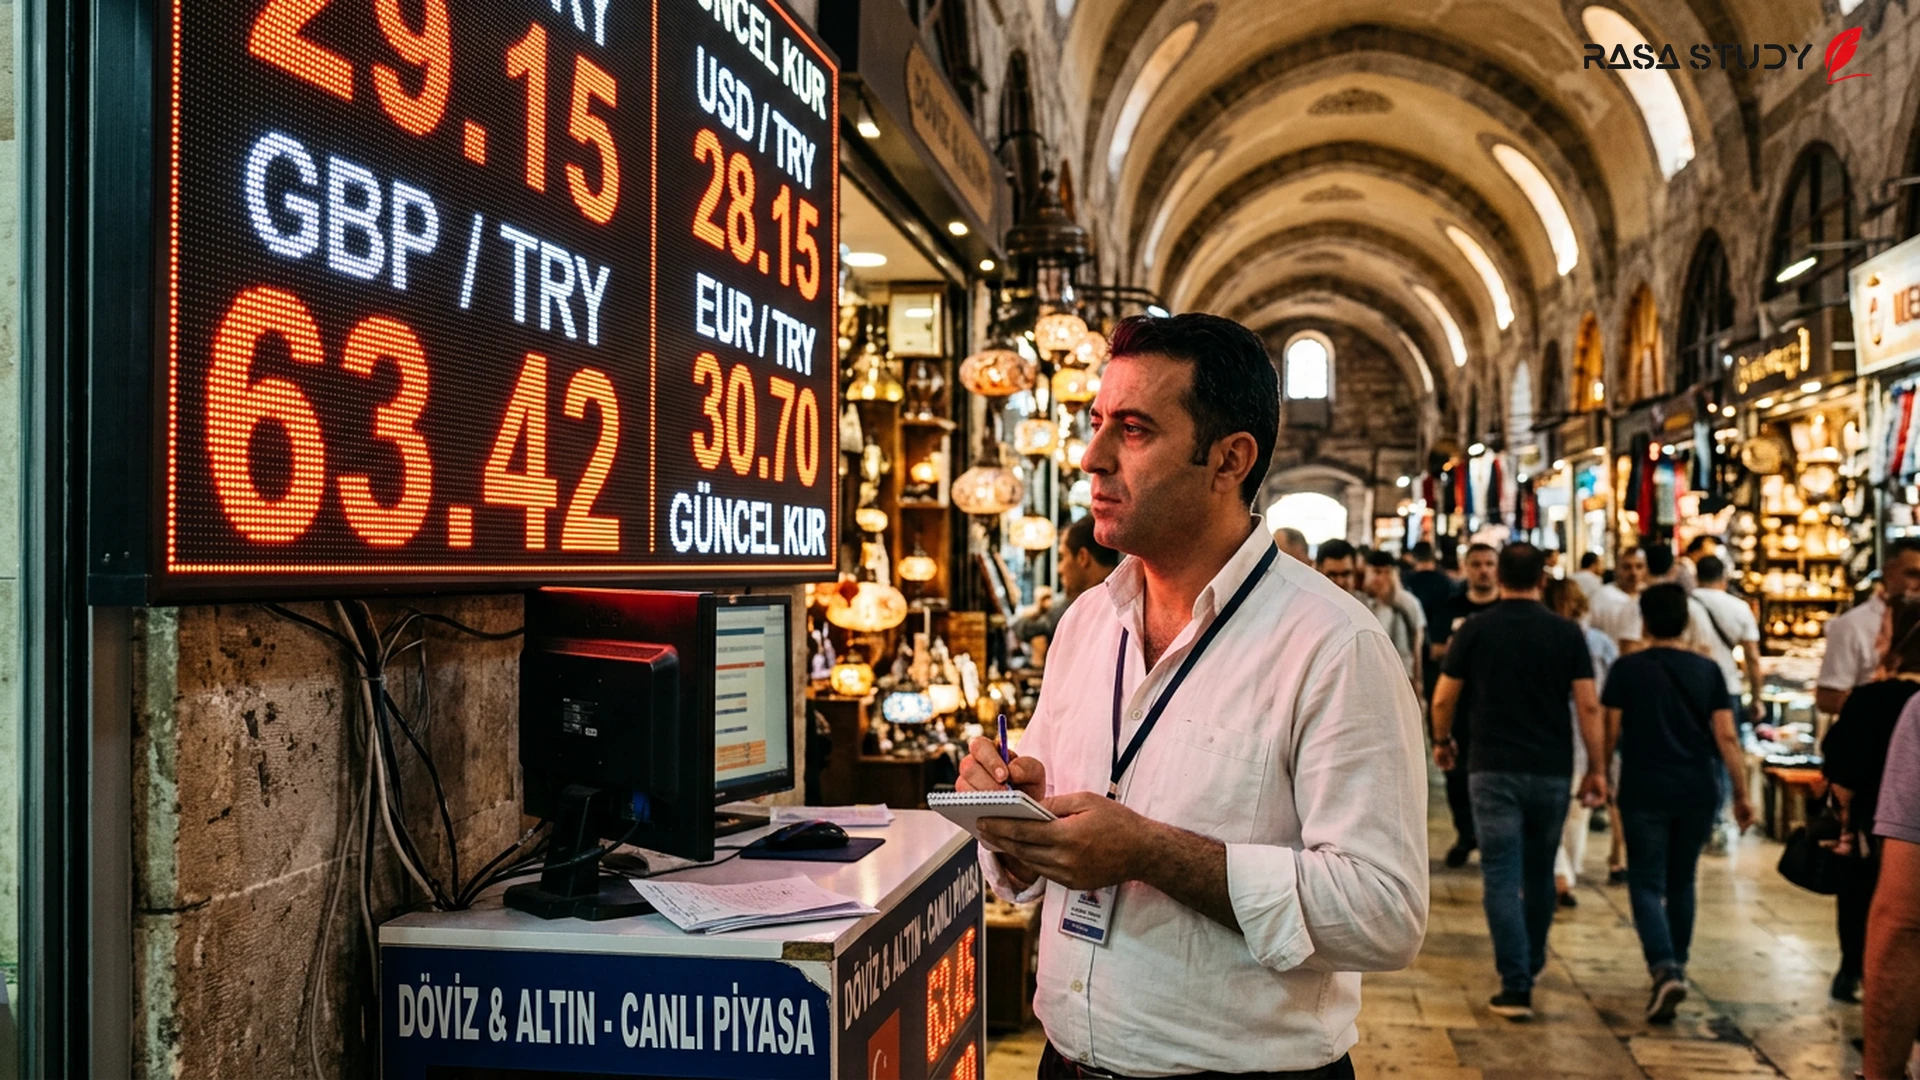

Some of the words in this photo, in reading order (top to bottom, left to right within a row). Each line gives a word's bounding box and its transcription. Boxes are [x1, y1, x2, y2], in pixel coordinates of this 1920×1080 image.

[696, 45, 755, 142] USD
[758, 102, 769, 153] /
[772, 110, 816, 190] TRY
[783, 37, 827, 121] KUR
[243, 131, 440, 291] GBP
[459, 213, 483, 309] /
[500, 224, 612, 346] TRY
[693, 128, 820, 301] 28.15
[696, 272, 754, 353] EUR
[758, 304, 769, 358] /
[772, 309, 816, 377] TRY
[205, 285, 620, 551] 63.42
[692, 352, 820, 487] 30.70
[669, 481, 779, 554] GÜNCEL
[784, 504, 827, 556] KUR
[398, 973, 480, 1041] DÖVİZ
[488, 987, 507, 1042] &
[516, 988, 596, 1046] ALTIN
[620, 992, 704, 1050] CANLI
[714, 982, 816, 1056] PİYASA
[844, 945, 881, 1031] DÖVİZ
[882, 943, 891, 992] &
[892, 914, 921, 982] ALTIN
[927, 885, 952, 945] CANLI
[927, 926, 976, 1063] 63.45
